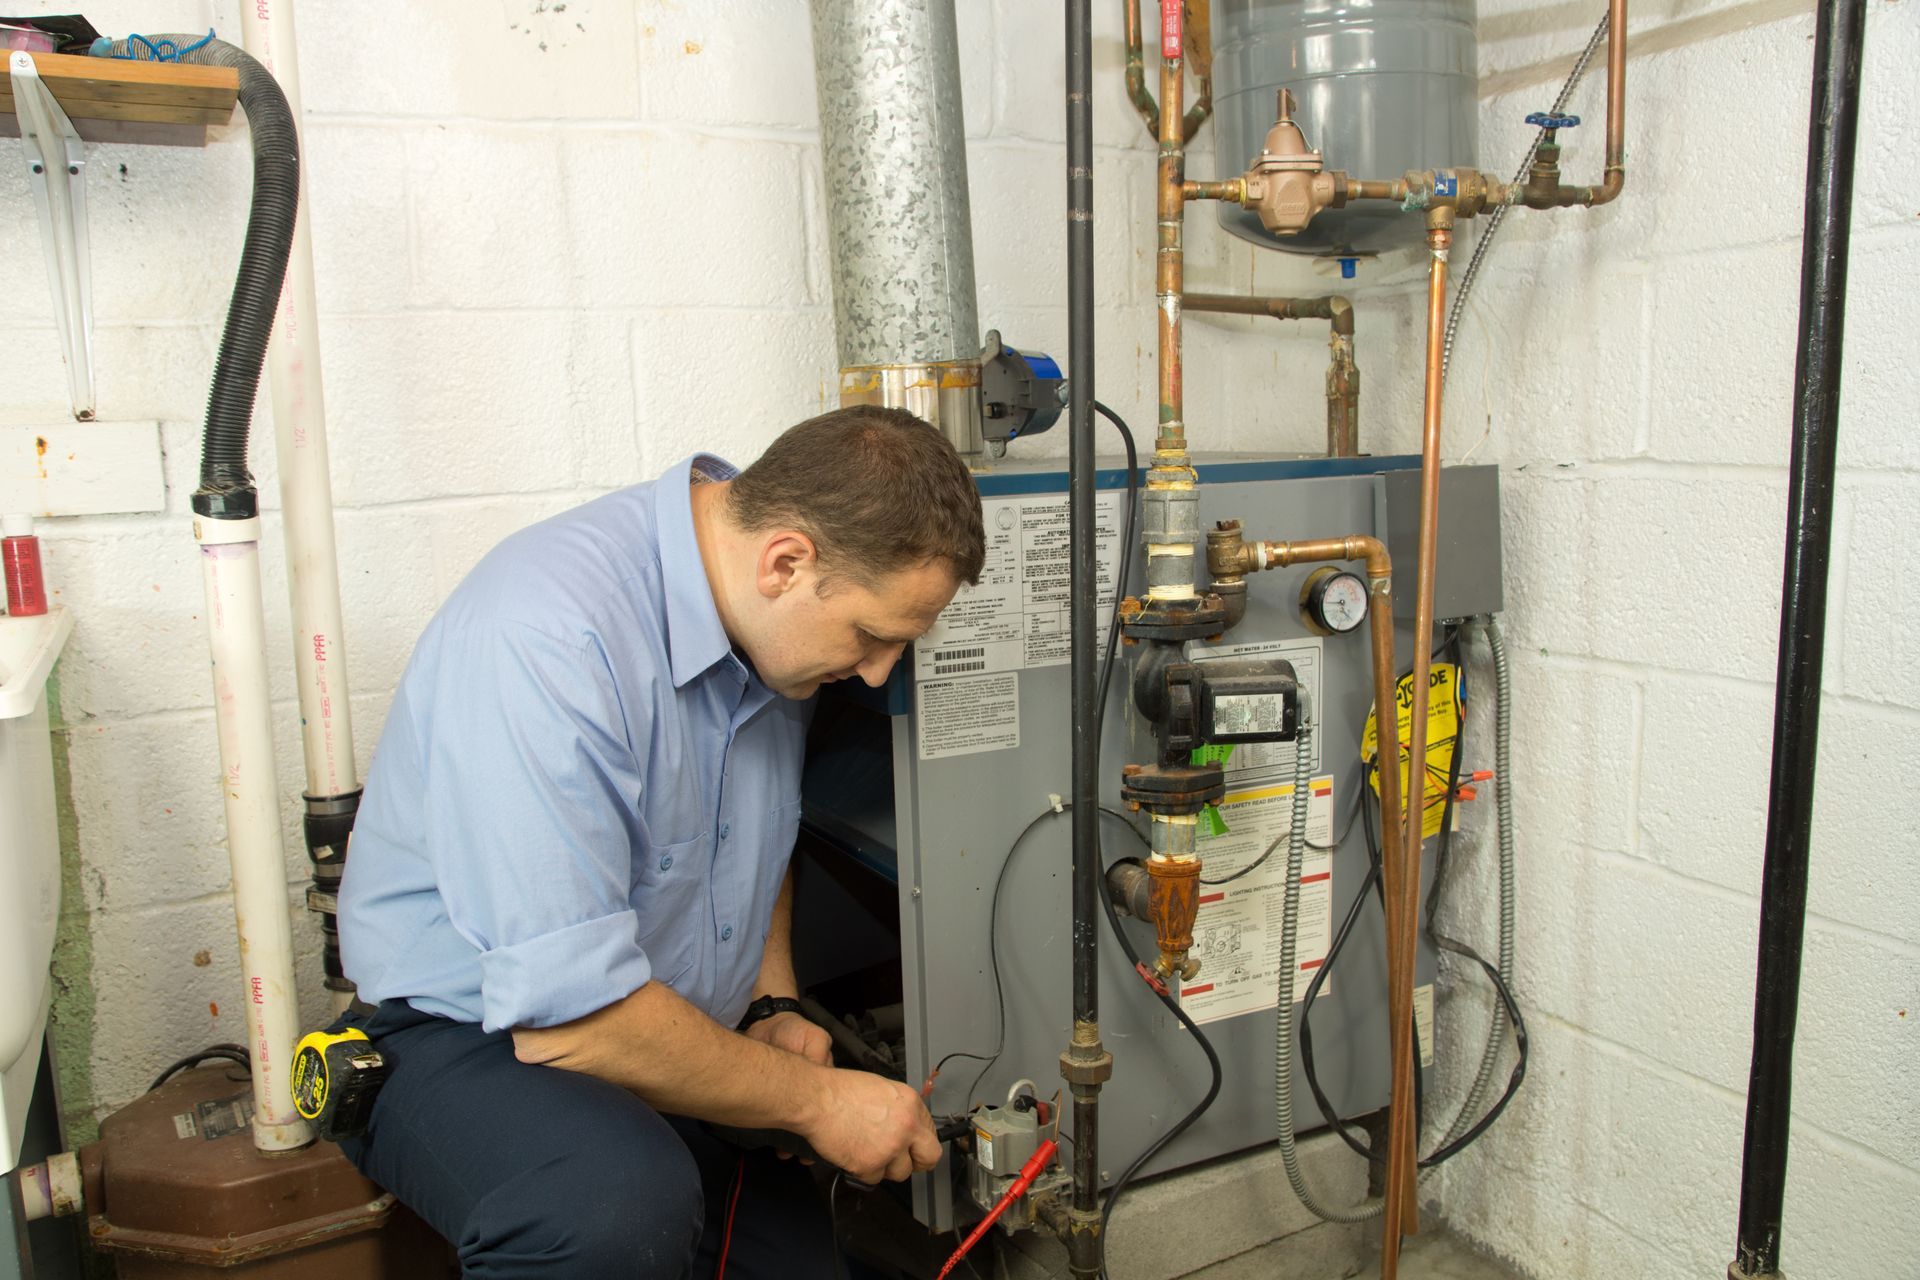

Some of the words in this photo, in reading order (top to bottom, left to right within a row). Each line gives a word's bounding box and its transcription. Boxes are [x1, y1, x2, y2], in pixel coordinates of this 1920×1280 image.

[1232, 801, 1252, 810] SAFETY
[1267, 796, 1288, 804] BEFORE
[1229, 887, 1253, 897] LIGHTING
[1225, 978, 1239, 986] TURN
[252, 977, 264, 1004] PPFA
